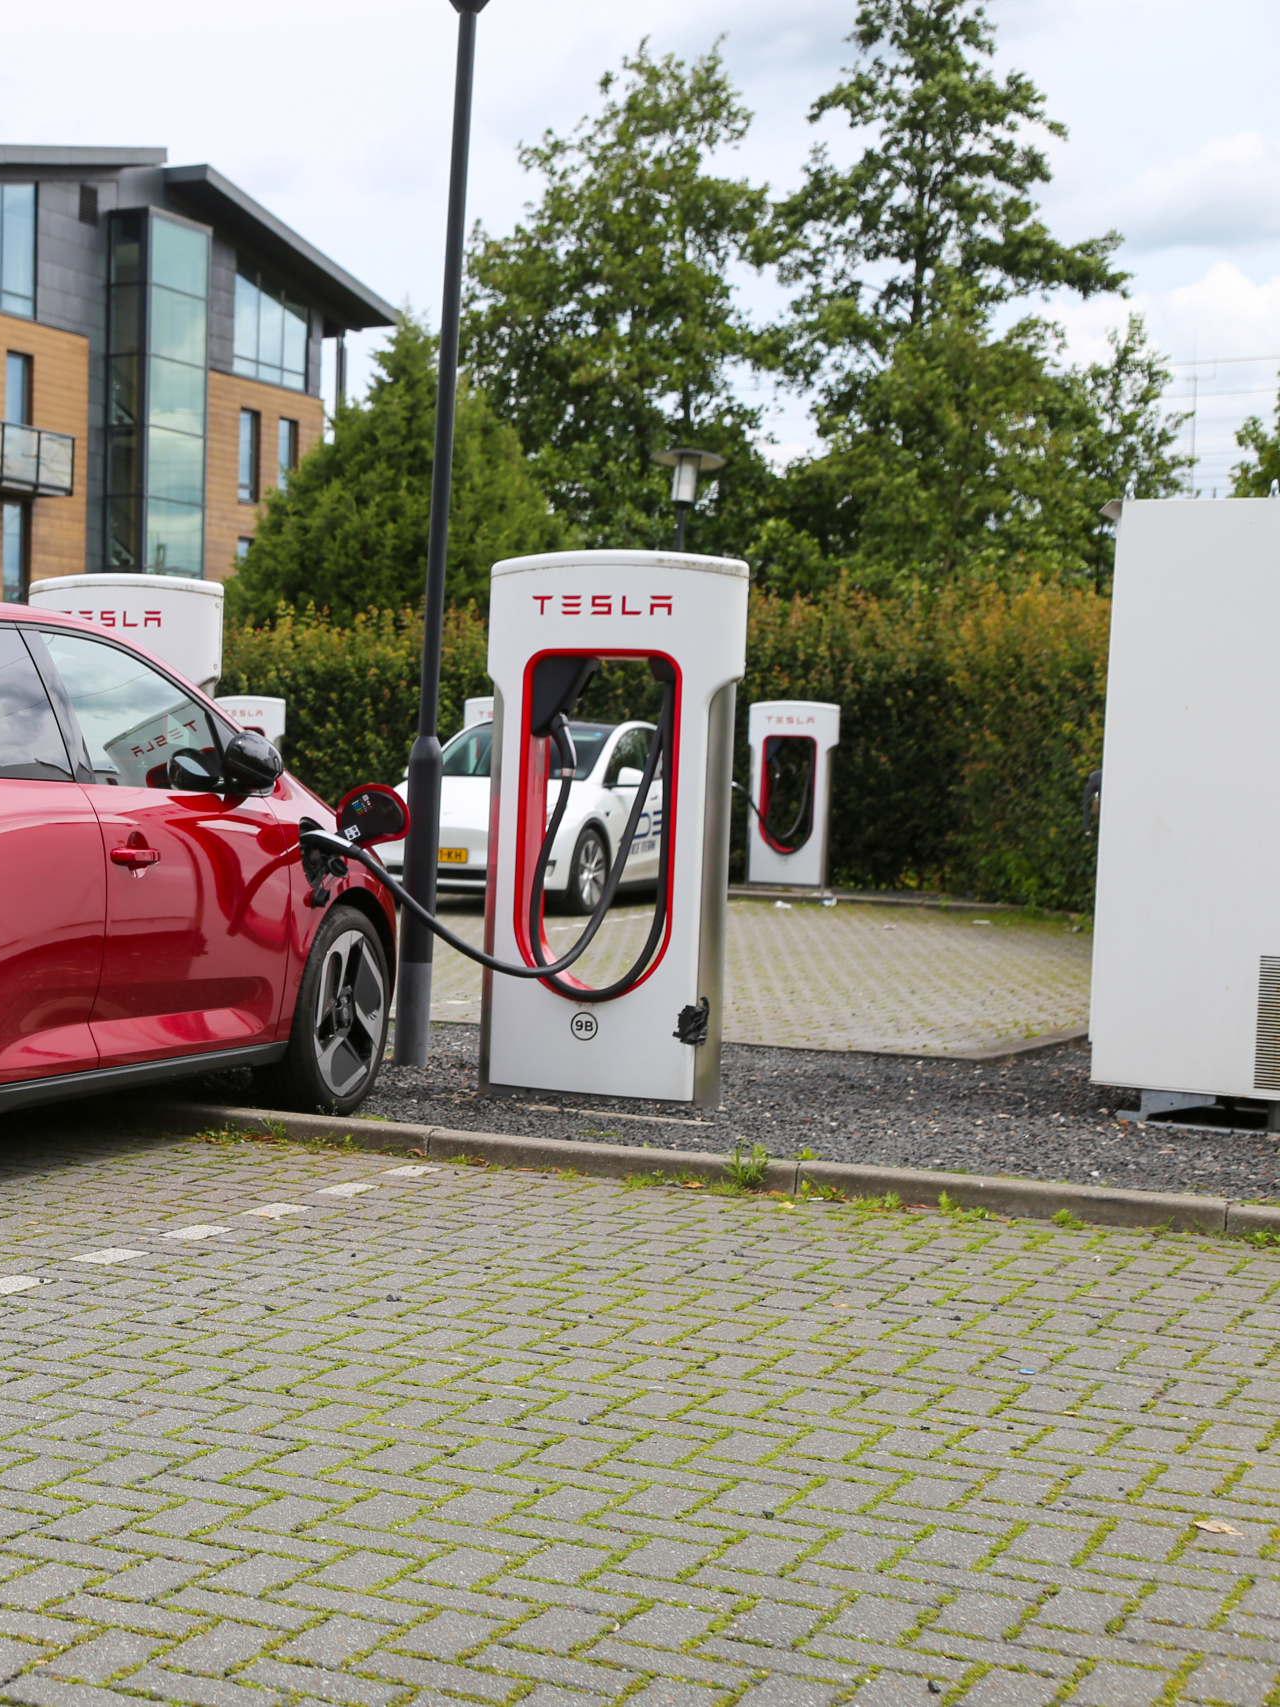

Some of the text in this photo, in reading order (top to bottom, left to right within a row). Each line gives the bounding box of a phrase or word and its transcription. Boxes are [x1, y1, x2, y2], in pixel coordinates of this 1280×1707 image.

[532, 595, 673, 616] TESLA
[766, 716, 816, 725] TESLA
[575, 1019, 594, 1032] 9B
